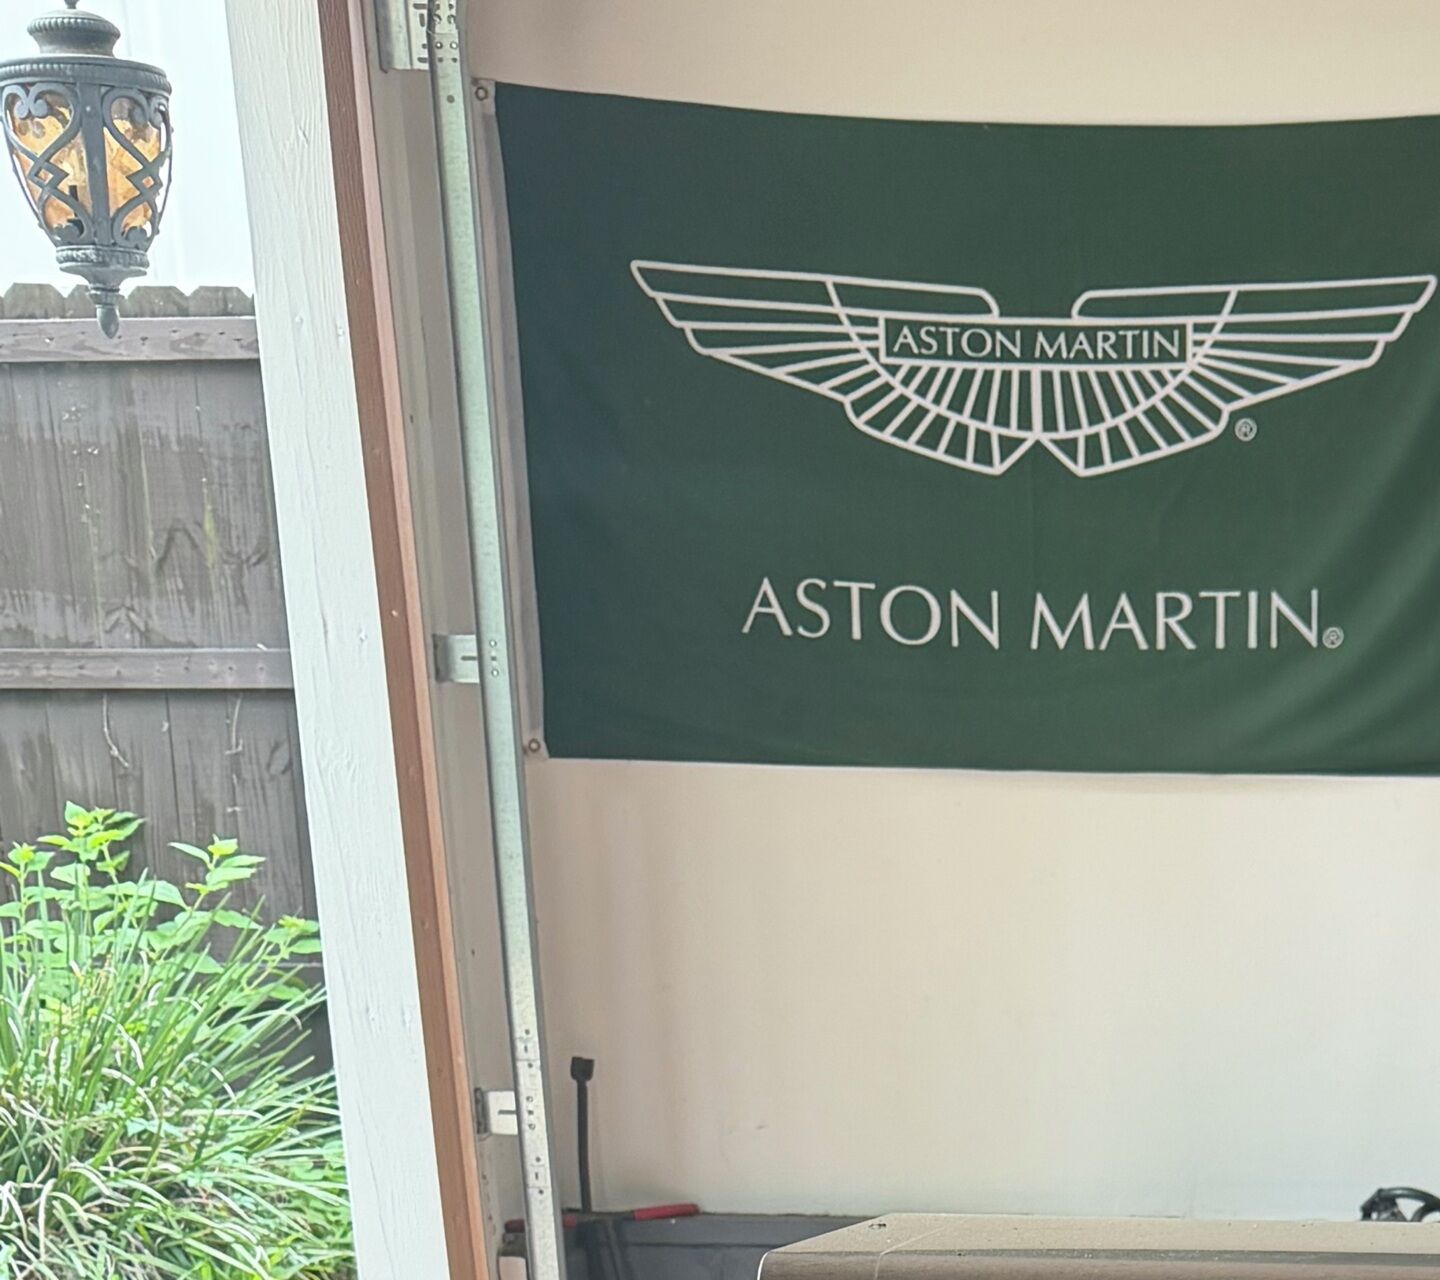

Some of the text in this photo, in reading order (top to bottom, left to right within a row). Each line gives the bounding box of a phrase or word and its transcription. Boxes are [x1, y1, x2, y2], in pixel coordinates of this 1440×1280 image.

[892, 325, 1180, 360] ASTON MARTIN
[742, 577, 1000, 650] ASTON
